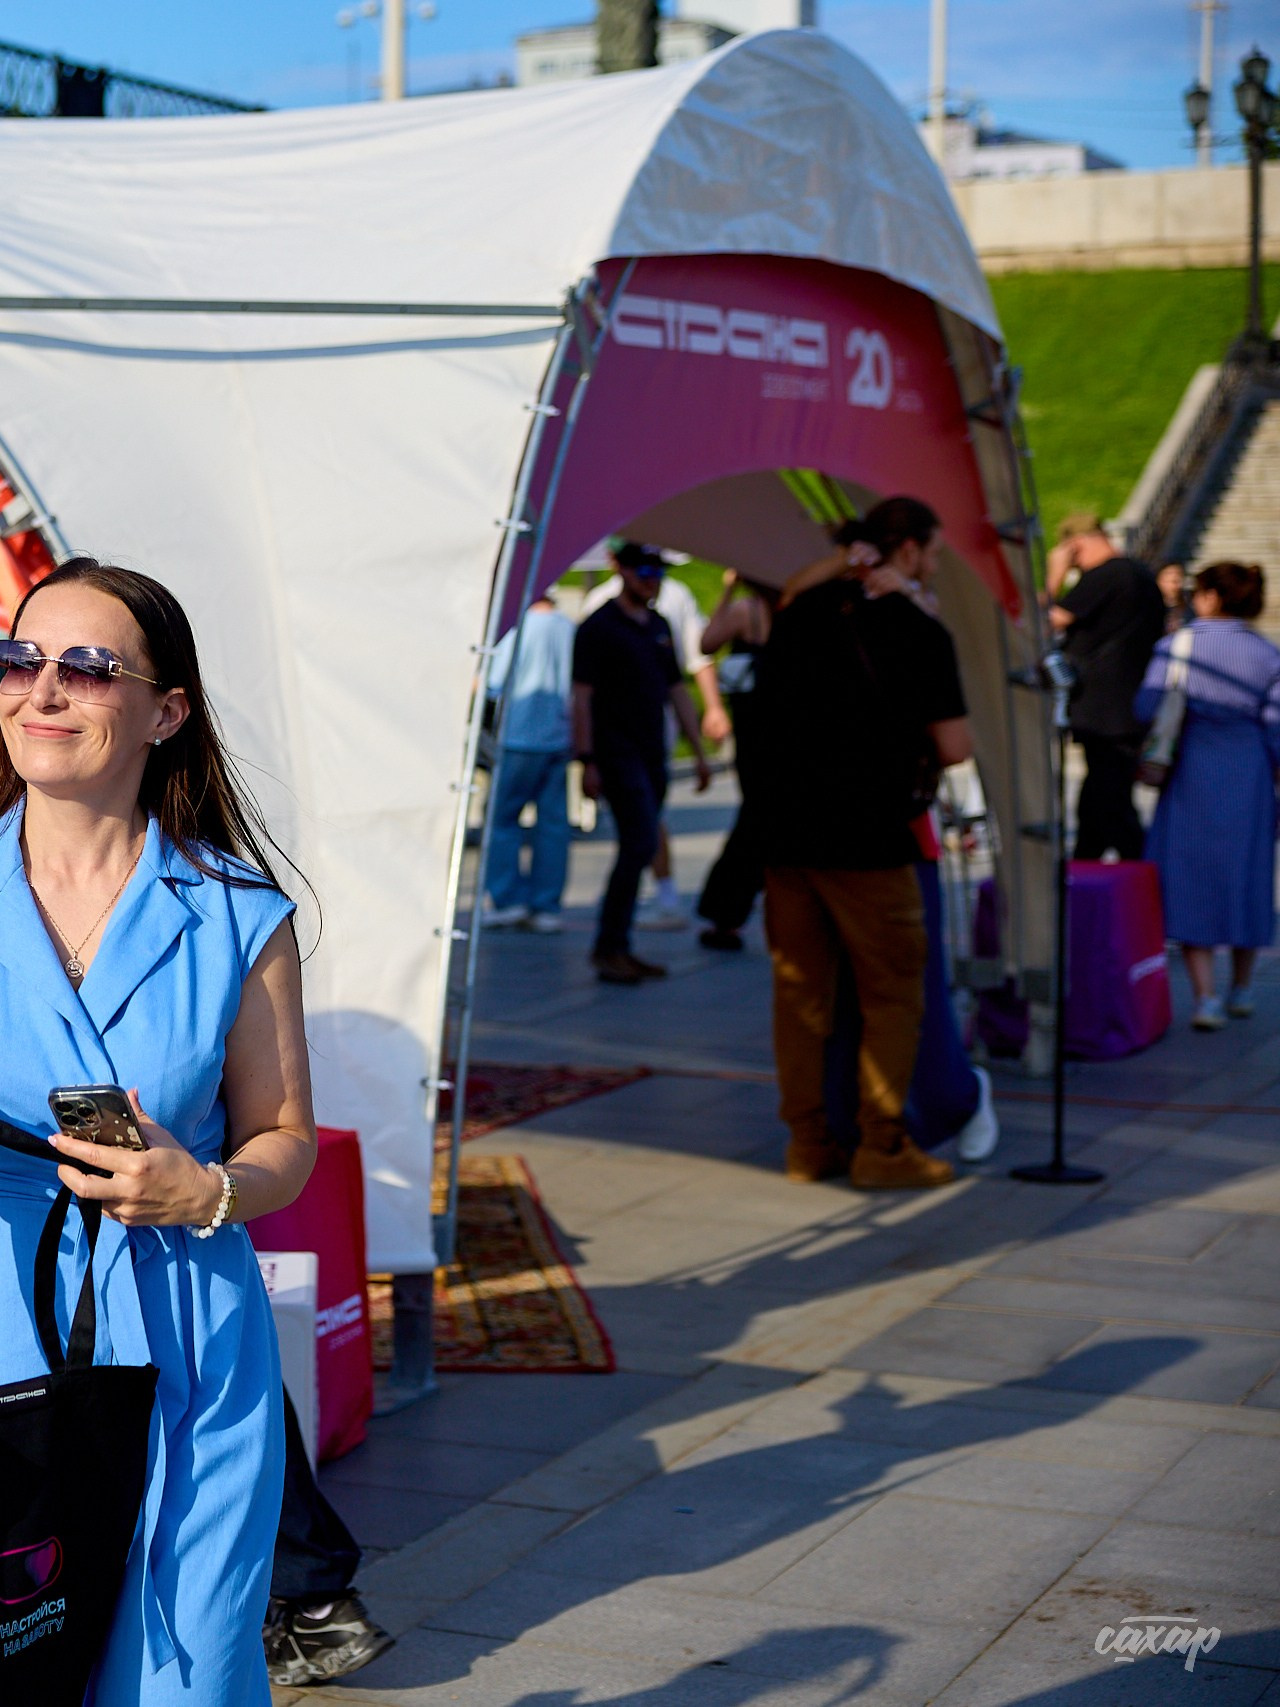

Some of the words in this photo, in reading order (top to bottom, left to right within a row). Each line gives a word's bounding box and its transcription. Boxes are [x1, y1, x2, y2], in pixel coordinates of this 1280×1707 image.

[845, 327, 892, 410] 20
[0, 1597, 65, 1639] НАСТРОЙСЯ
[3, 1638, 21, 1657] НА
